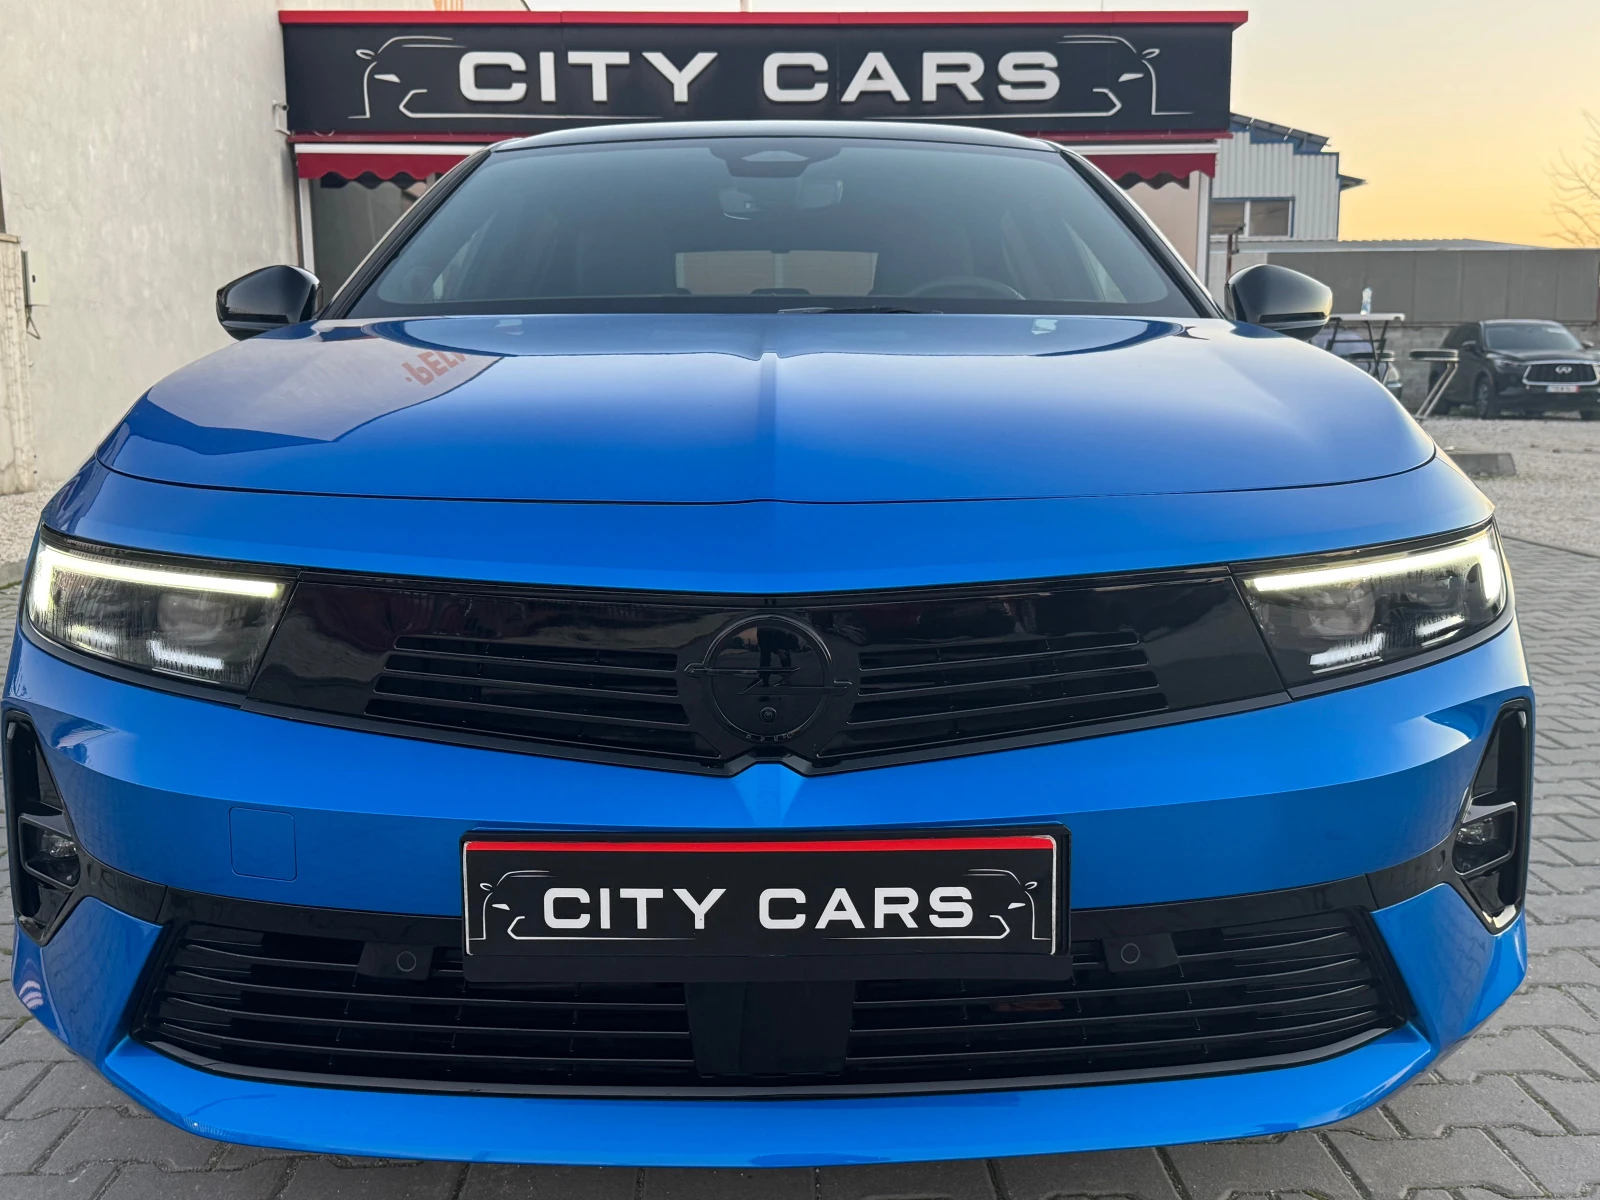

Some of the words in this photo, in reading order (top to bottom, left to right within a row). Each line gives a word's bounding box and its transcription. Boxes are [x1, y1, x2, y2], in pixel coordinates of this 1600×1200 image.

[459, 51, 718, 102] CITY
[763, 51, 1060, 102] CARS
[543, 887, 727, 930] CITY
[759, 886, 974, 930] CARS
